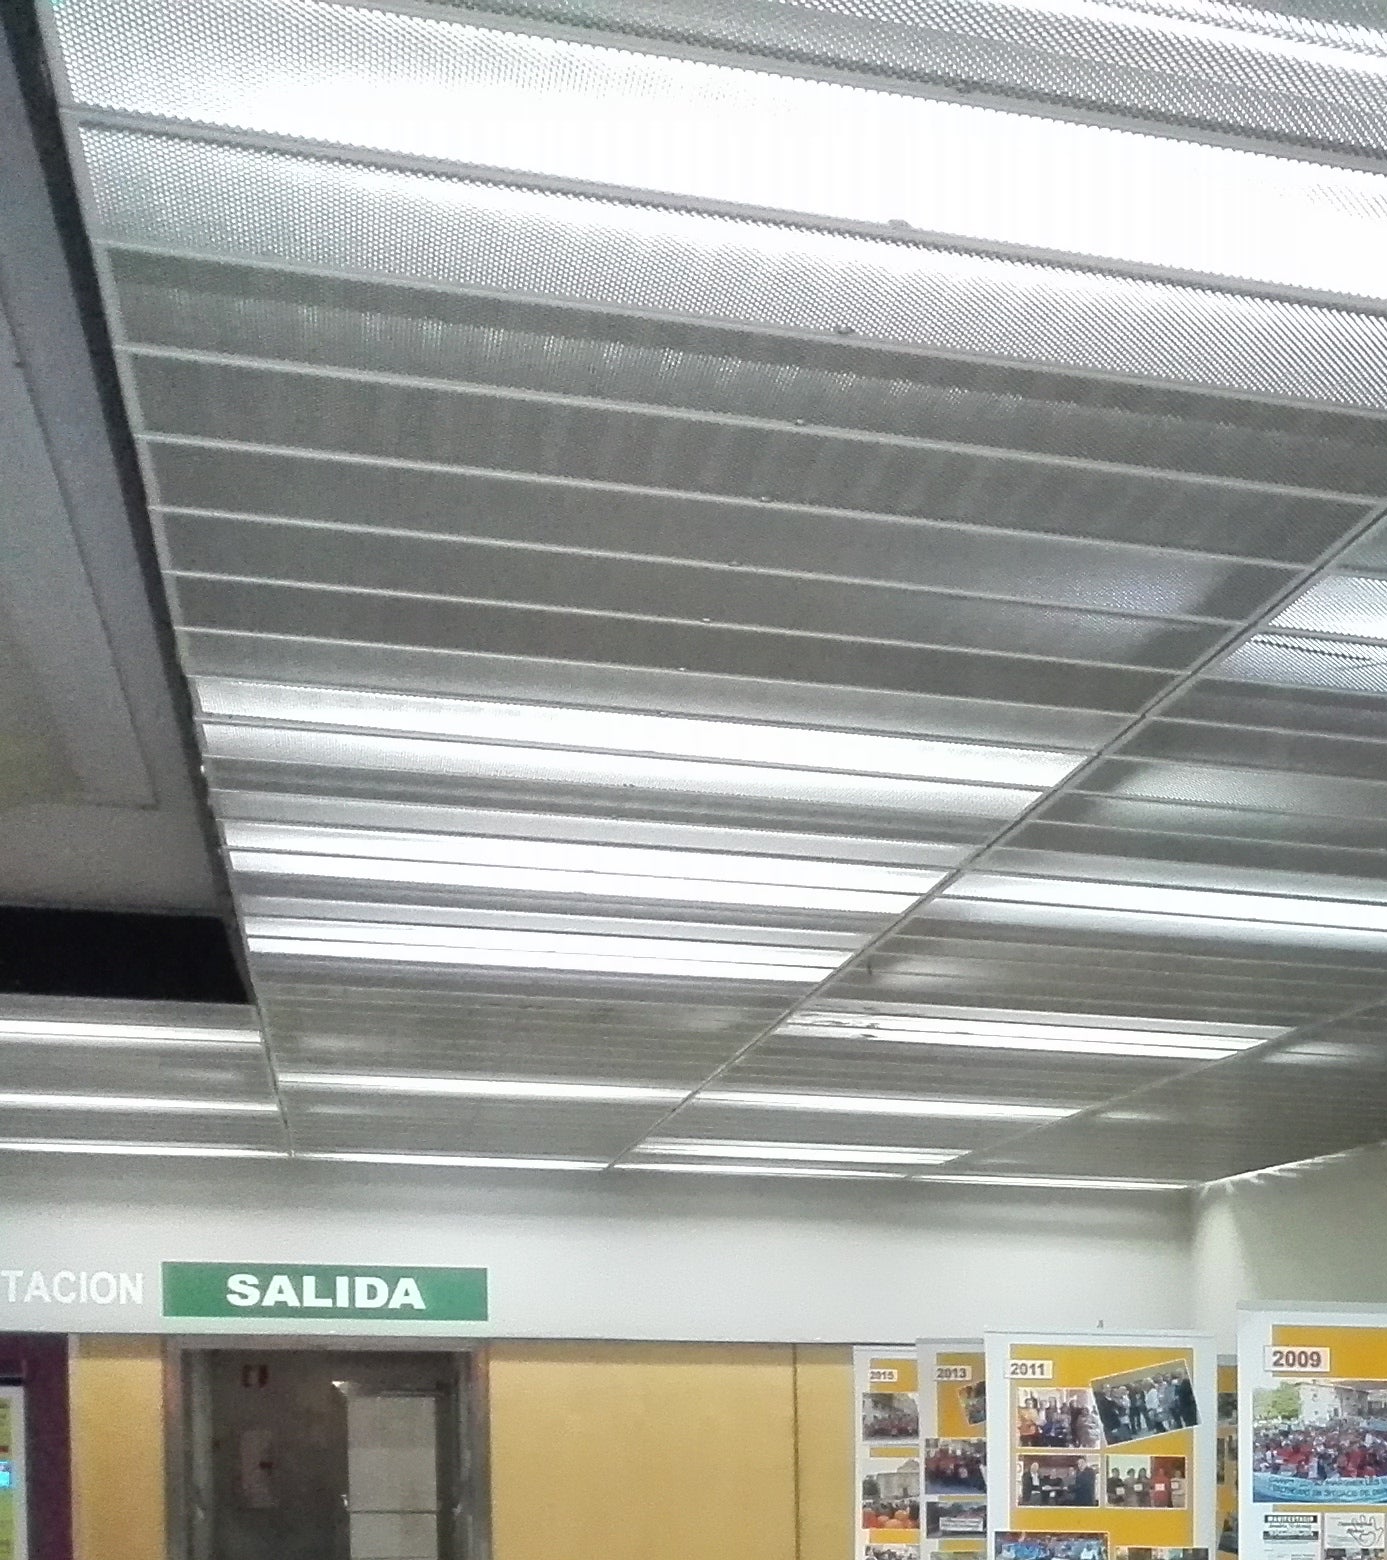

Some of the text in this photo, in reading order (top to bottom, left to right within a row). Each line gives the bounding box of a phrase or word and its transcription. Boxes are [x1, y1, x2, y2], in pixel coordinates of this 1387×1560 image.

[225, 1273, 427, 1311] SALIDA
[1272, 1350, 1321, 1367] 2009
[936, 1367, 967, 1378] 2013
[1010, 1363, 1045, 1376] 2011
